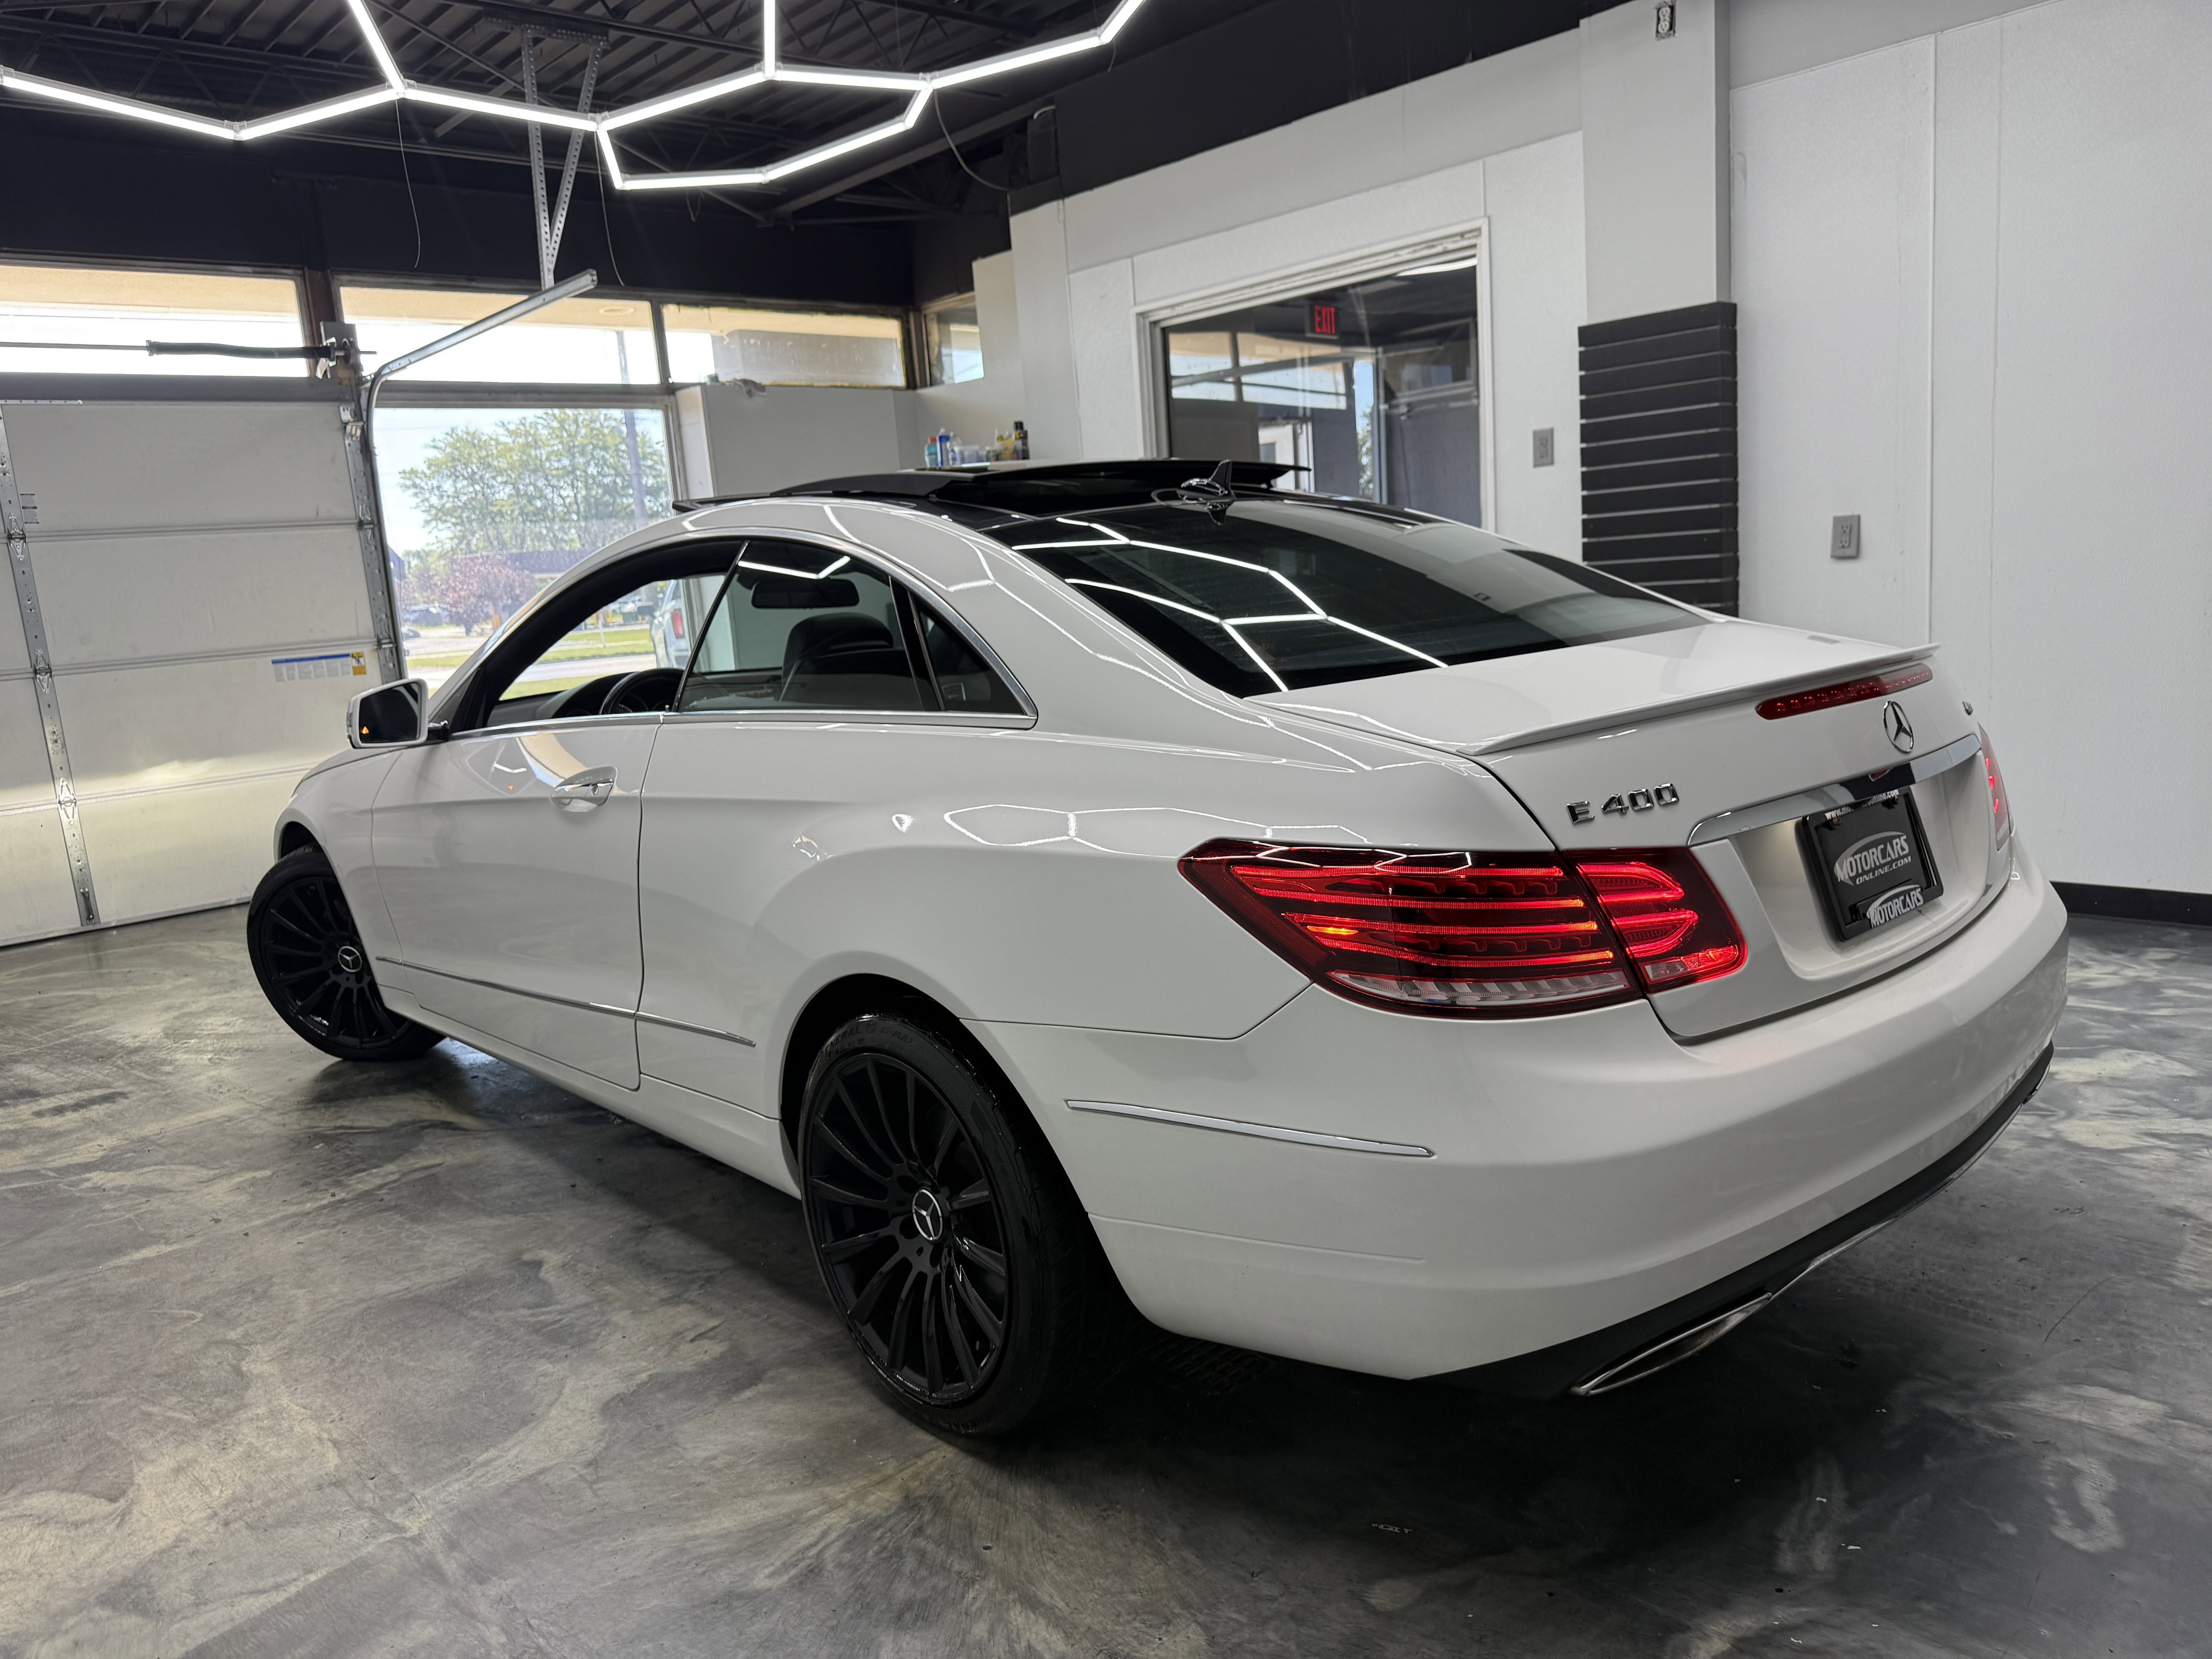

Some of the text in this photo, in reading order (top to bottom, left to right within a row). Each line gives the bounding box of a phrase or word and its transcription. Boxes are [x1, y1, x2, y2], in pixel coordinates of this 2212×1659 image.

[1314, 305, 1336, 335] EXIT
[1566, 783, 1680, 824] E 400
[1835, 835, 1909, 882] MOTORCARS
[1856, 855, 1911, 885] ONLINE.COM
[1868, 888, 1924, 928] MOTORCARS
